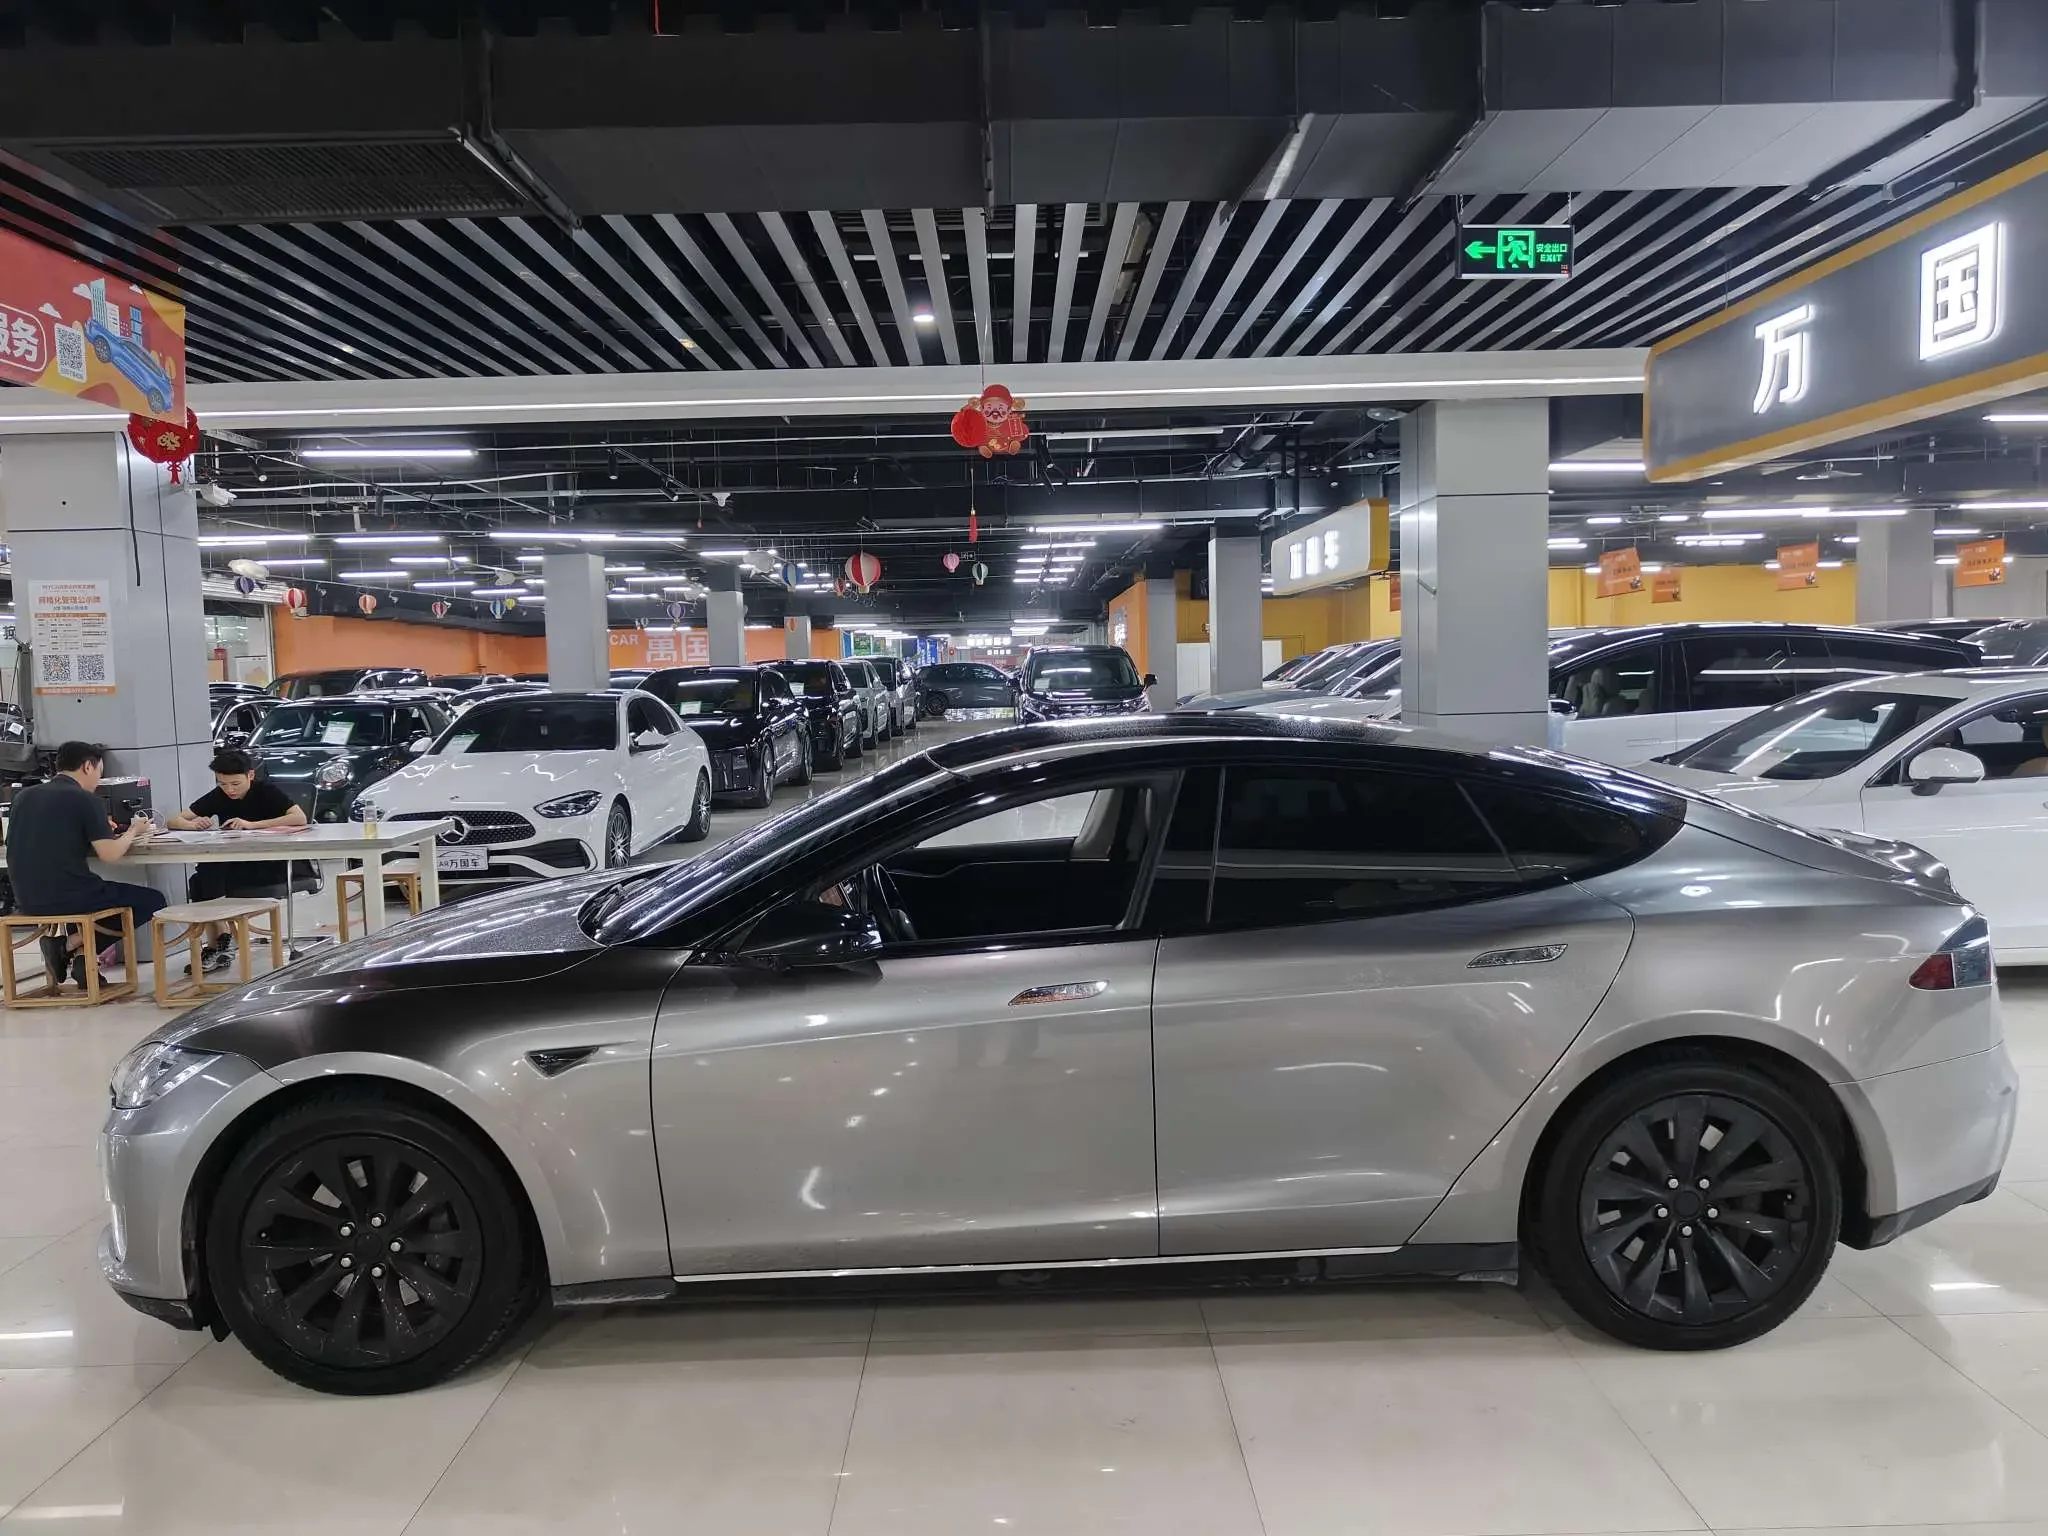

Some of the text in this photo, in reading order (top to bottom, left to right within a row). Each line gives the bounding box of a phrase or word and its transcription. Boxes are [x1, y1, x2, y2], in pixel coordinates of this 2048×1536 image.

[1535, 243, 1568, 253] 安全出口
[1540, 254, 1562, 262] EXIT
[1753, 221, 2006, 414] 万国
[609, 634, 639, 645] CAR
